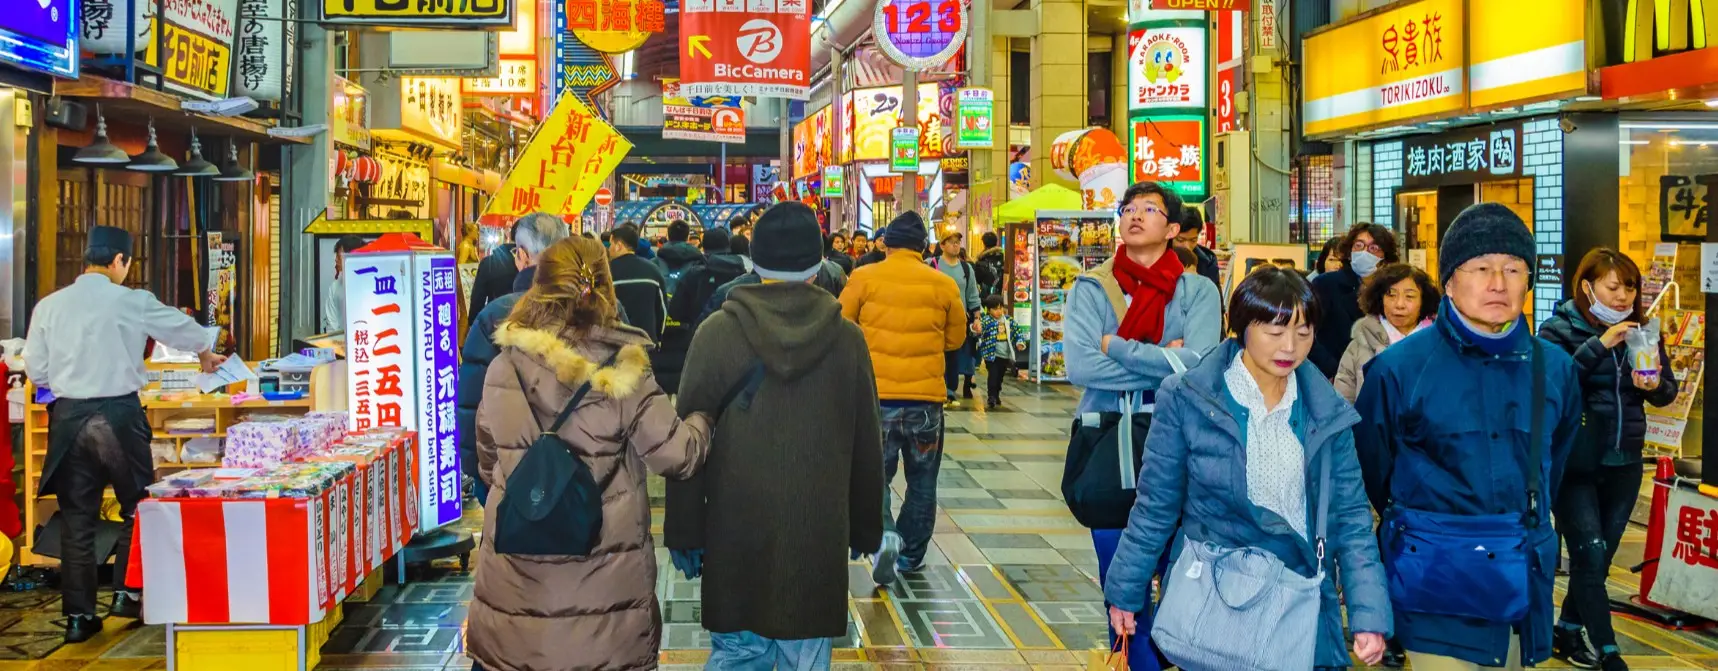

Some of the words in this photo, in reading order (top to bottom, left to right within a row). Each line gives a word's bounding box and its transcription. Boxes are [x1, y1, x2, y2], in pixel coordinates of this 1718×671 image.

[714, 63, 803, 80] BicCamera
[1381, 76, 1443, 105] TORIKIZOKU
[1135, 136, 1201, 178] 北の家族
[1407, 137, 1488, 177] 焼肉酒家
[422, 271, 434, 361] MAWARU
[425, 367, 436, 433] conveyor
[427, 437, 437, 466] belt
[428, 470, 437, 507] sushi
